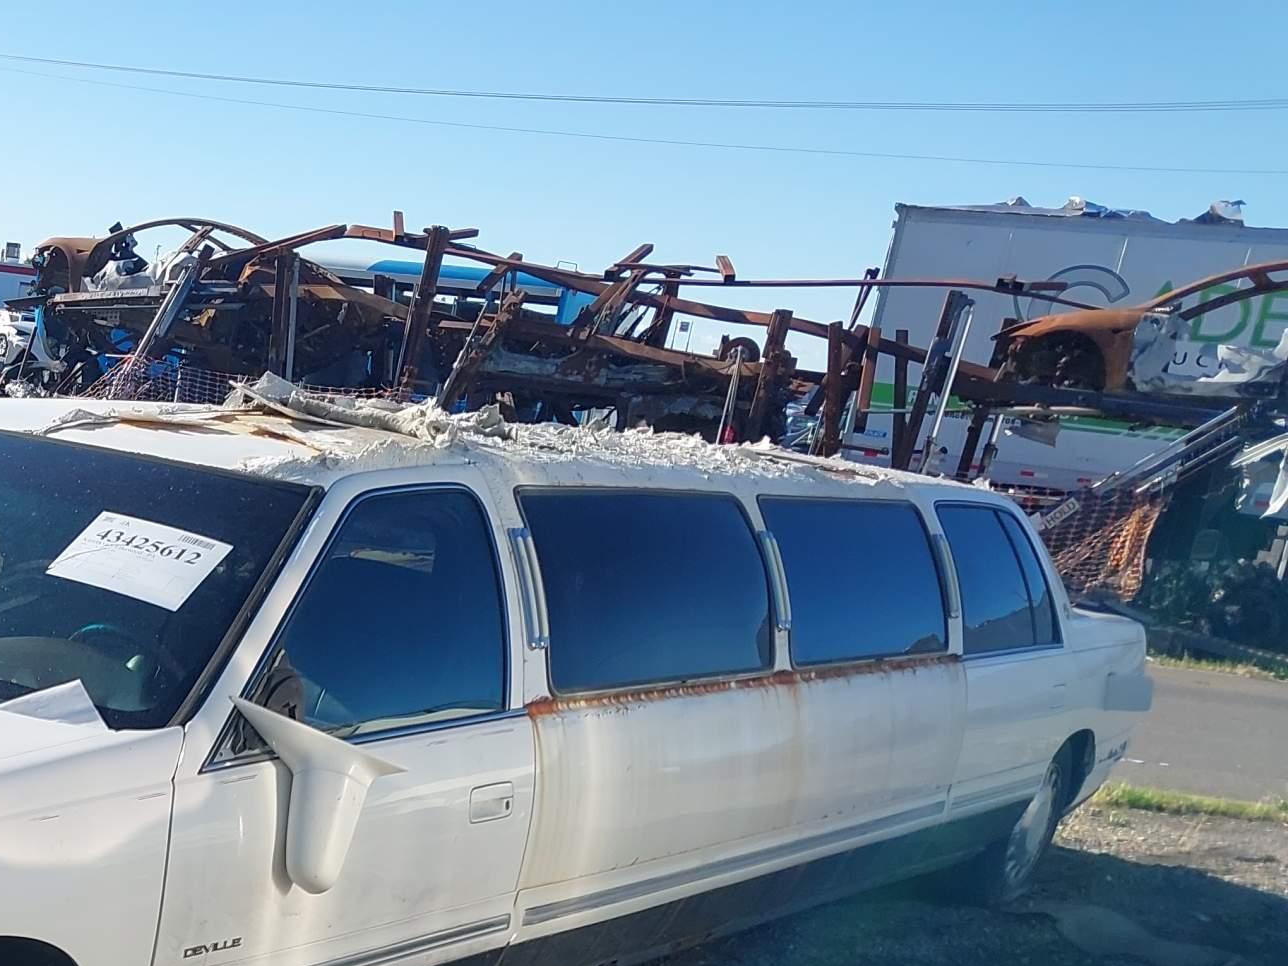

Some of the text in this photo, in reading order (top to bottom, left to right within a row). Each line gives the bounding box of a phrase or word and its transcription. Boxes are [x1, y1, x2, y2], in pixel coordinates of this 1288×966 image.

[1046, 500, 1077, 527] HOLD
[96, 528, 202, 565] 43425612
[183, 937, 242, 959] DEVILLE
